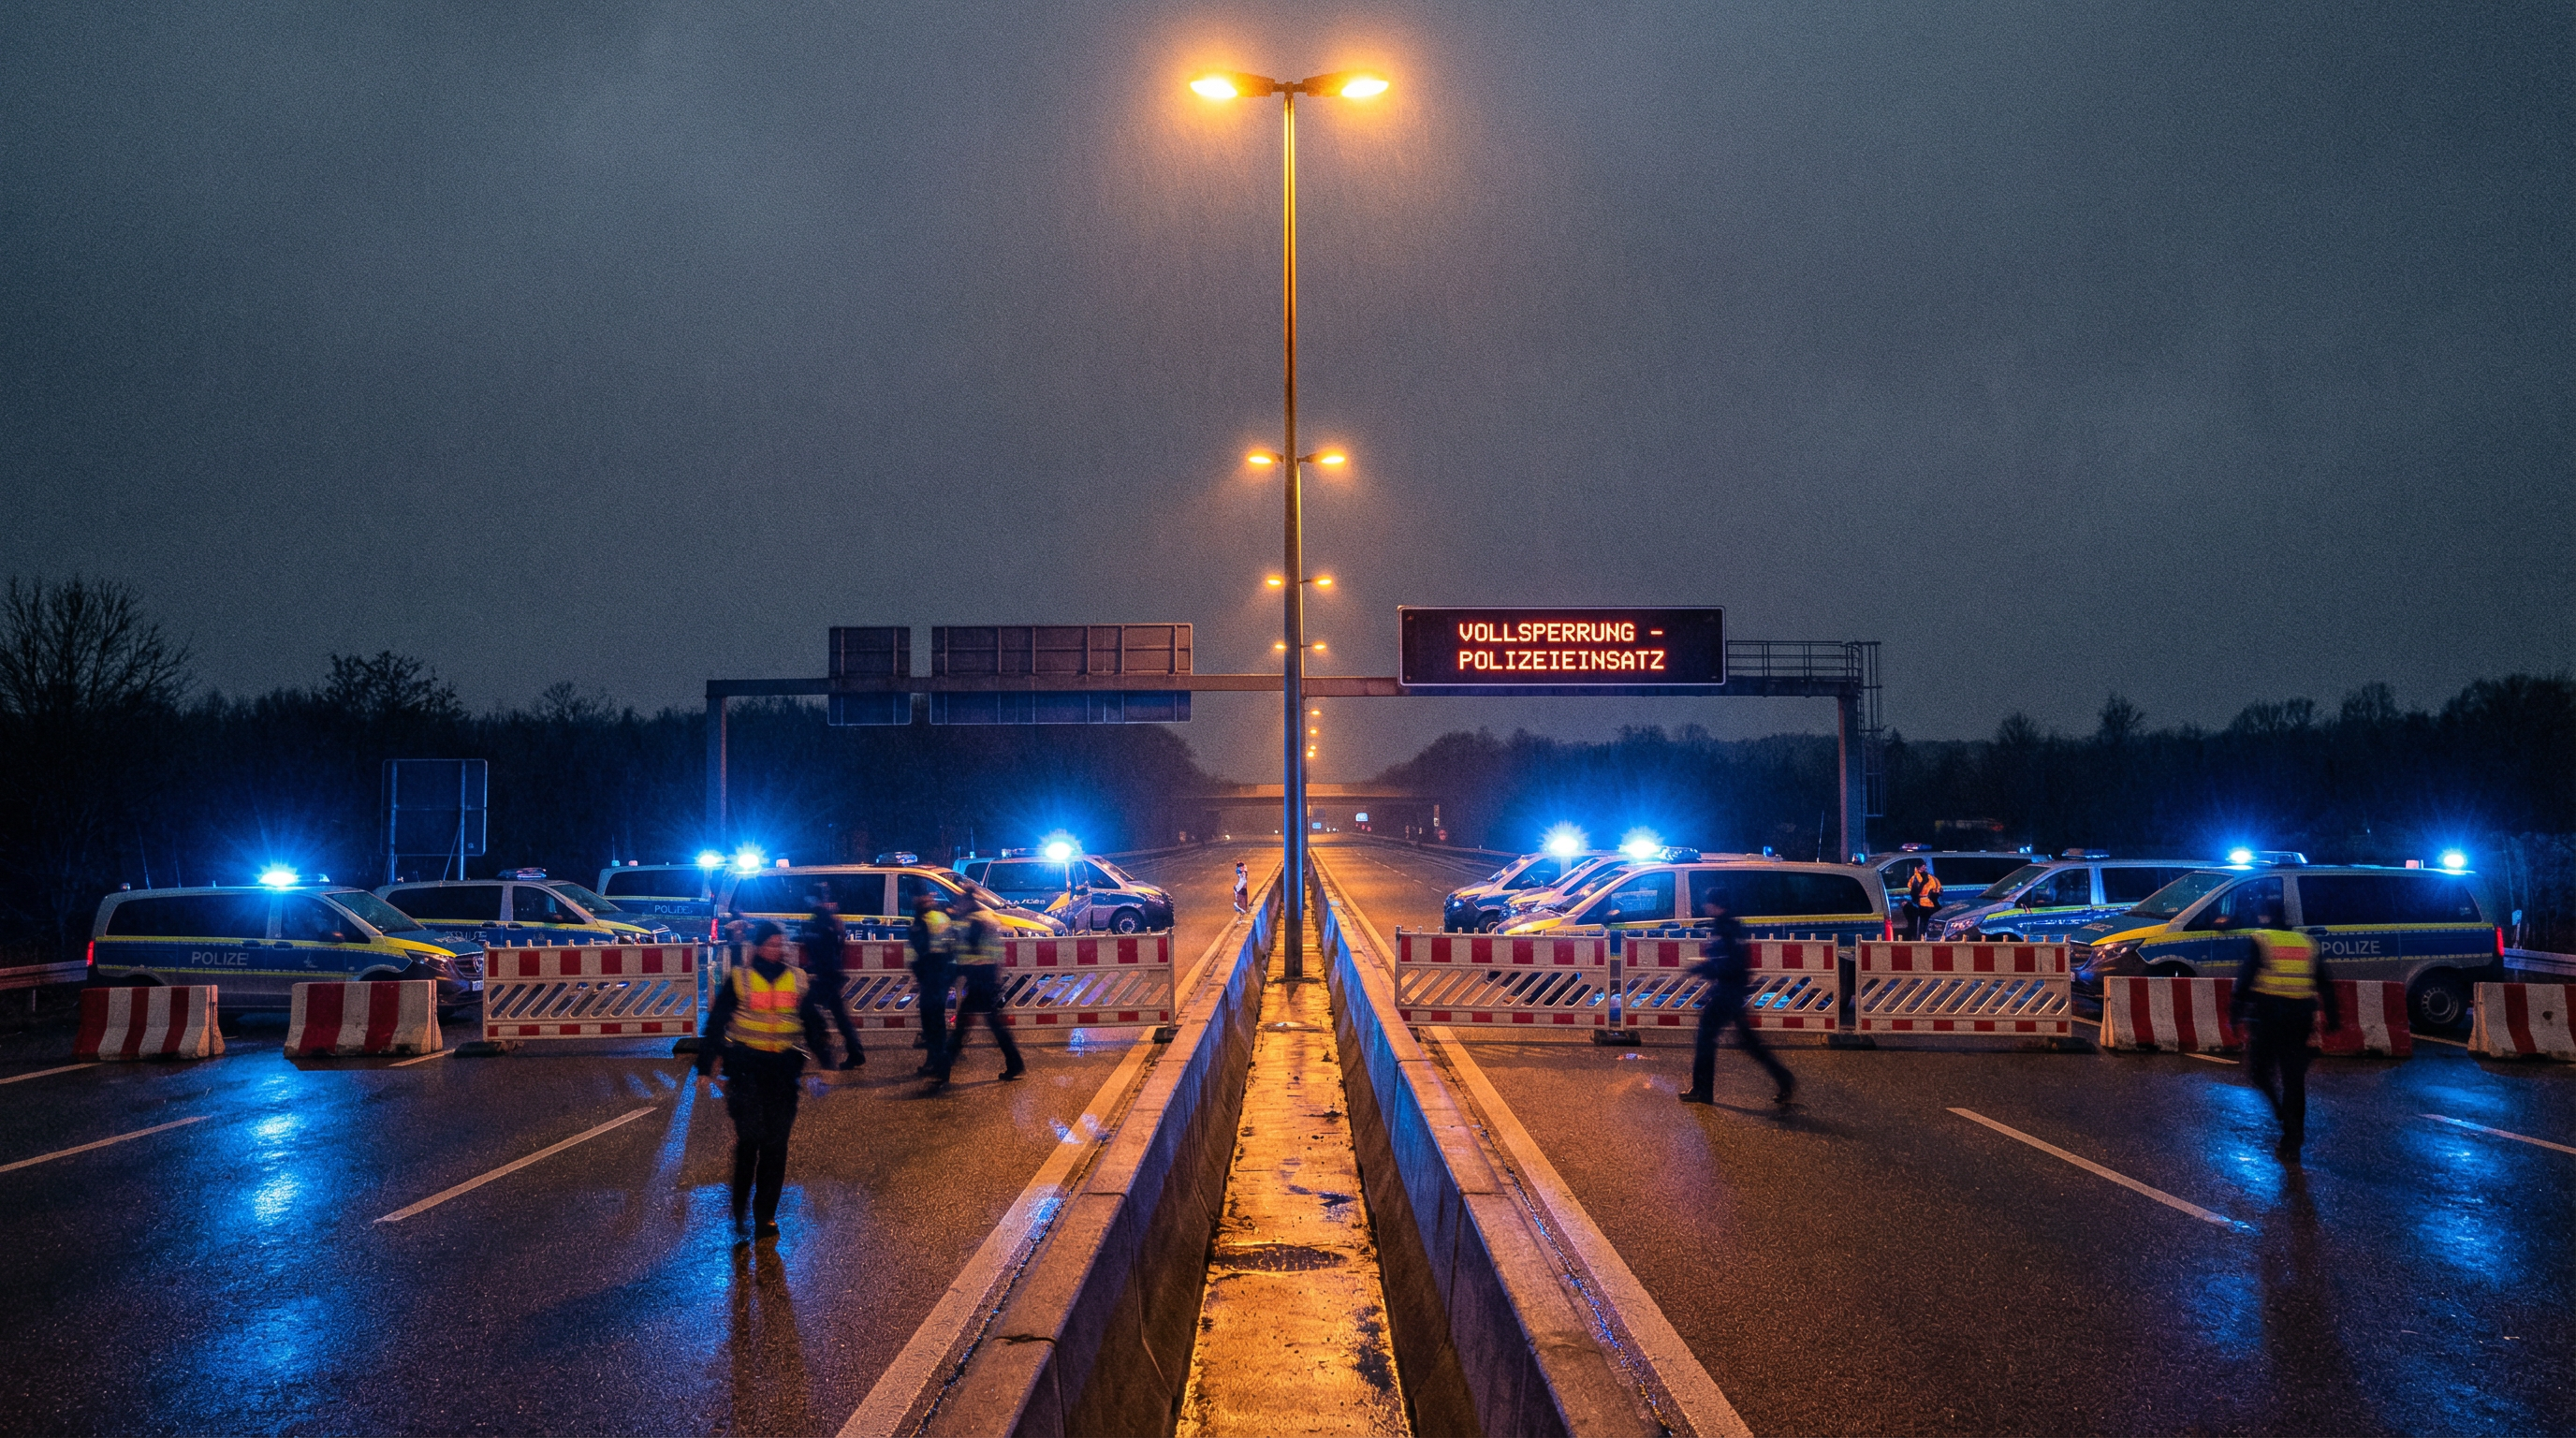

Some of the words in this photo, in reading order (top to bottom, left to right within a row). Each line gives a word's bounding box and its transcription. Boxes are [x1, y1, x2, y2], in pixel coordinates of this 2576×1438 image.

[1458, 623, 1635, 642] VOLLSPERRUNG
[1458, 651, 1664, 670] POLIZEIEINSATZ
[2321, 940, 2381, 955] POLIZE
